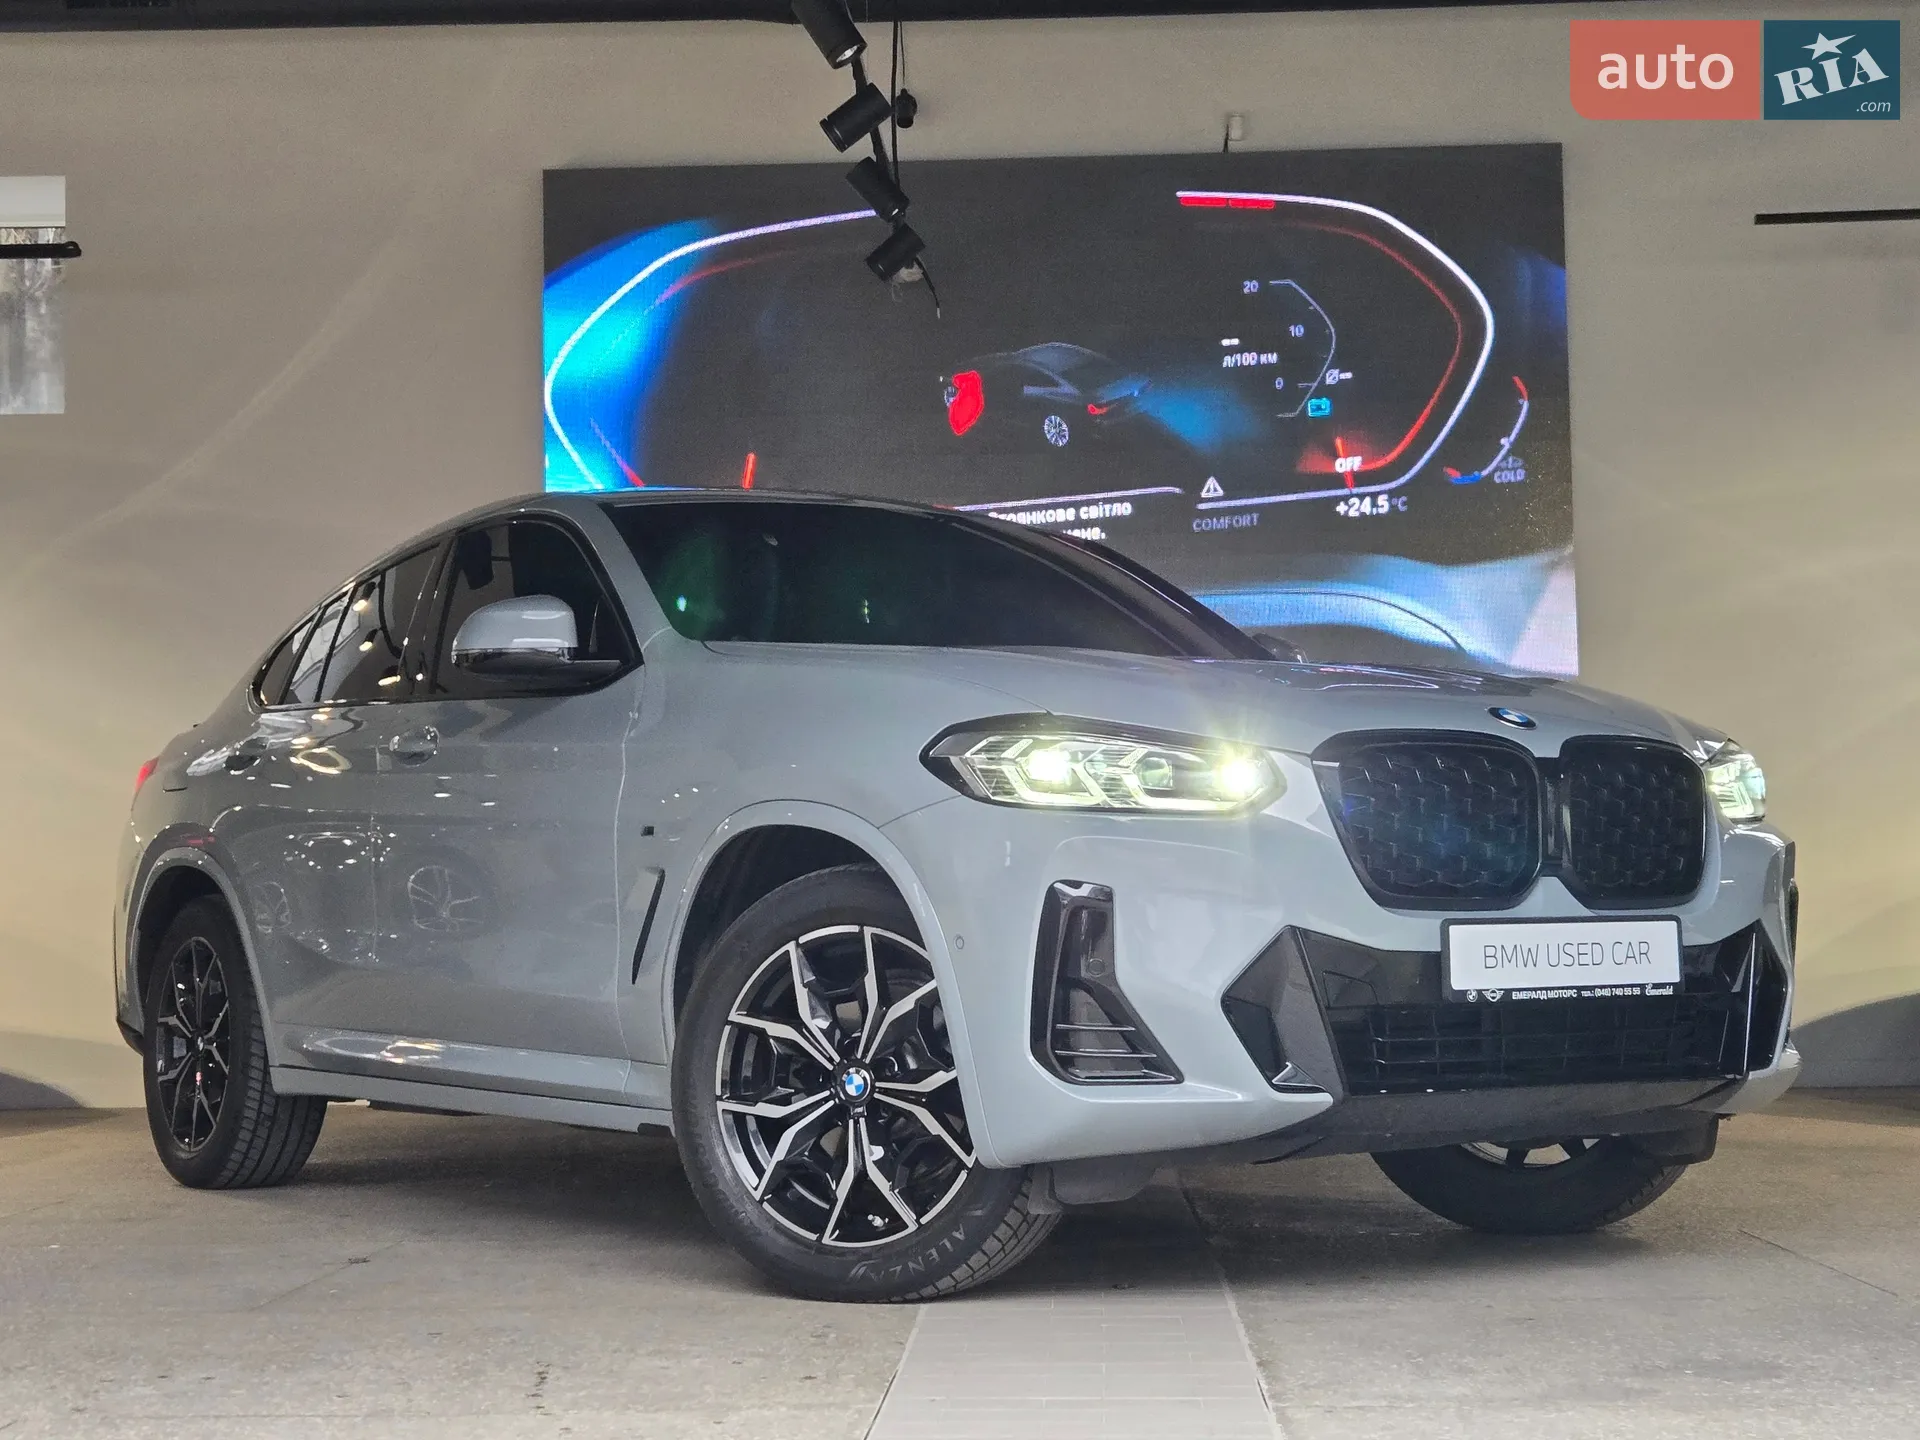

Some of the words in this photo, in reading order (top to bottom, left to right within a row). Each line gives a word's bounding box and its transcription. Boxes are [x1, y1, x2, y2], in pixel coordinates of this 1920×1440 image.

[1243, 280, 1259, 294] 20
[1289, 324, 1304, 337] 10
[1275, 377, 1284, 390] 0
[1334, 456, 1362, 473] OFF
[1192, 512, 1260, 533] COMFORT
[1483, 943, 1540, 969] BMW
[1546, 942, 1604, 968] USED
[1611, 940, 1652, 966] CAR
[1547, 989, 1578, 998] МОТОРС
